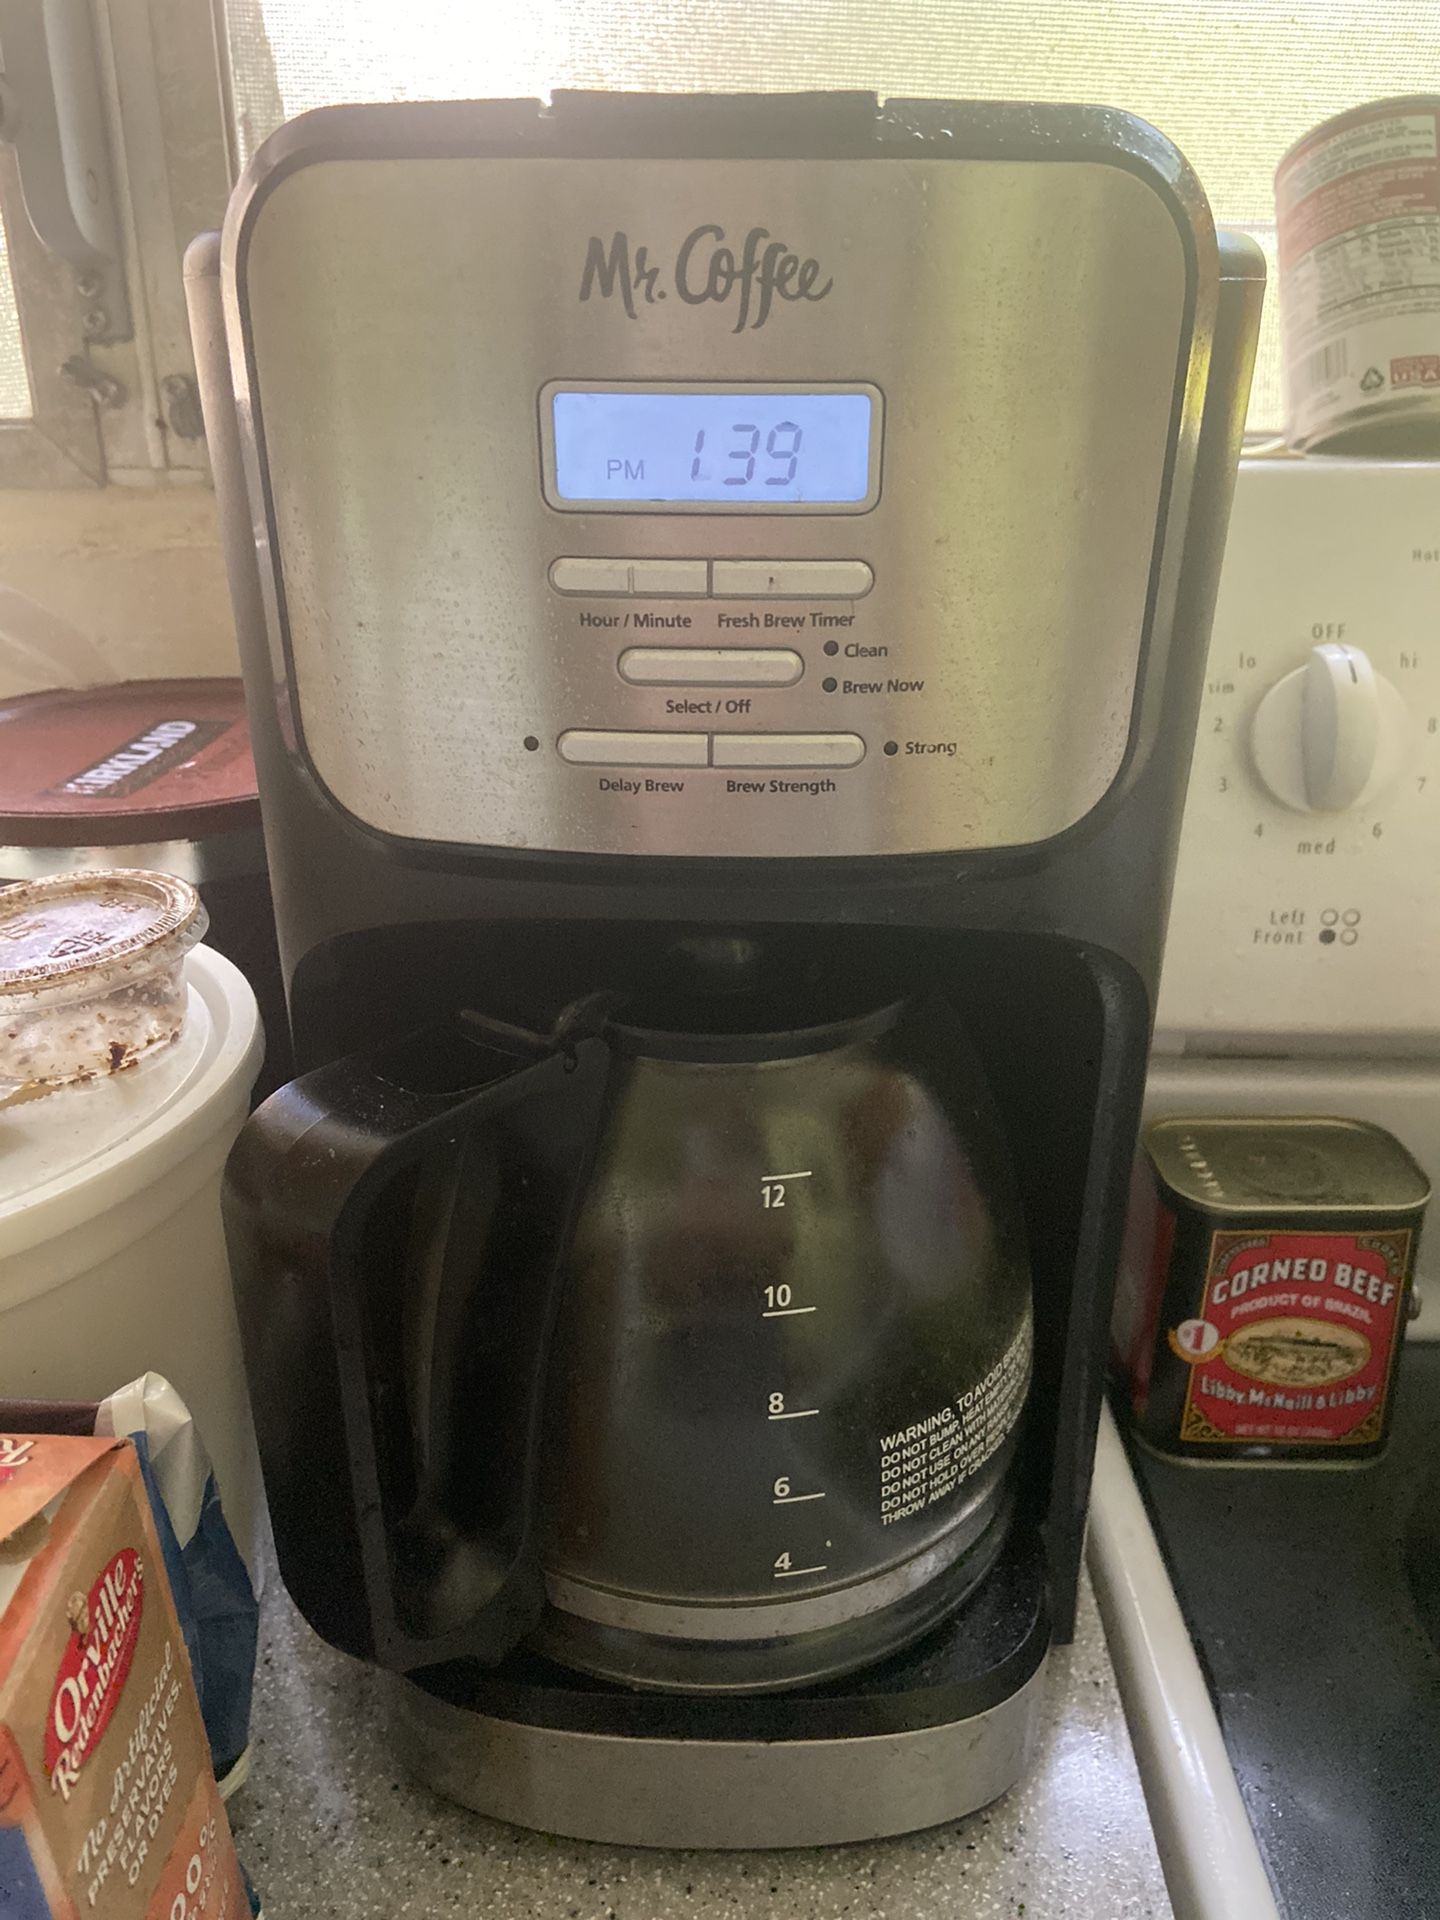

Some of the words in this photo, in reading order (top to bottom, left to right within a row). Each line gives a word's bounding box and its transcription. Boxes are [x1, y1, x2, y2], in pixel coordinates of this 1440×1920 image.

[579, 231, 667, 319] Mr.
[675, 224, 833, 334] Coffee
[606, 458, 645, 481] PM
[579, 612, 619, 629] Hour
[633, 612, 692, 629] Minute
[717, 612, 760, 628] Fresh
[764, 613, 805, 628] Brew
[809, 612, 856, 628] Timer
[1311, 624, 1347, 639] OFF
[844, 642, 888, 658] Clean
[1400, 652, 1418, 669] hi
[842, 678, 883, 694] Brew
[887, 678, 924, 693] Now
[665, 699, 713, 714] Select
[725, 698, 751, 714] Off
[1213, 716, 1224, 733] 2
[1427, 716, 1438, 734] 8
[904, 739, 957, 757] Strong
[599, 778, 641, 796] Delay
[644, 778, 684, 794] Brew
[726, 778, 765, 794] Brew
[769, 778, 836, 797] Strength
[1219, 776, 1229, 793] 3
[1416, 775, 1427, 793] 7
[1253, 822, 1264, 838] 4
[1372, 821, 1383, 839] 6
[1297, 837, 1336, 854] med
[1269, 908, 1305, 926] Left
[1253, 928, 1304, 944] Front
[760, 1184, 786, 1208] 12
[1212, 1258, 1328, 1305] CORNED
[1334, 1262, 1396, 1308] BEEF
[763, 1284, 792, 1307] 10
[1230, 1293, 1299, 1319] PRODUCT
[1301, 1294, 1322, 1308] OF
[767, 1392, 785, 1414] 8
[880, 1407, 955, 1452] WARNING,
[956, 1392, 973, 1412] TO
[974, 1363, 1003, 1401] AVOID
[881, 1453, 900, 1467] DO
[902, 1439, 927, 1461] NOT
[962, 1399, 986, 1426] HEAT
[881, 1468, 900, 1482] DO
[902, 1455, 927, 1476] NOT
[929, 1432, 963, 1461] CLEAN
[964, 1411, 986, 1437] WITH
[881, 1483, 900, 1497] DO
[902, 1469, 927, 1490] NOT
[929, 1456, 951, 1474] USE
[953, 1441, 968, 1460] ON
[969, 1425, 986, 1449] ANY
[773, 1477, 790, 1497] 6
[881, 1497, 900, 1513] DO
[902, 1484, 927, 1503] NOT
[929, 1465, 958, 1490] HOLD
[960, 1442, 985, 1469] OVER
[881, 1498, 925, 1526] THROW
[928, 1479, 957, 1505] AWAY
[957, 1472, 968, 1488] IF
[773, 1552, 792, 1571] 4
[54, 1558, 127, 1743] Orville
[109, 1640, 173, 1814] Artificial
[119, 1740, 173, 1871] FLAVORS
[128, 1839, 148, 1887] OR
[148, 1763, 178, 1839] DYES
